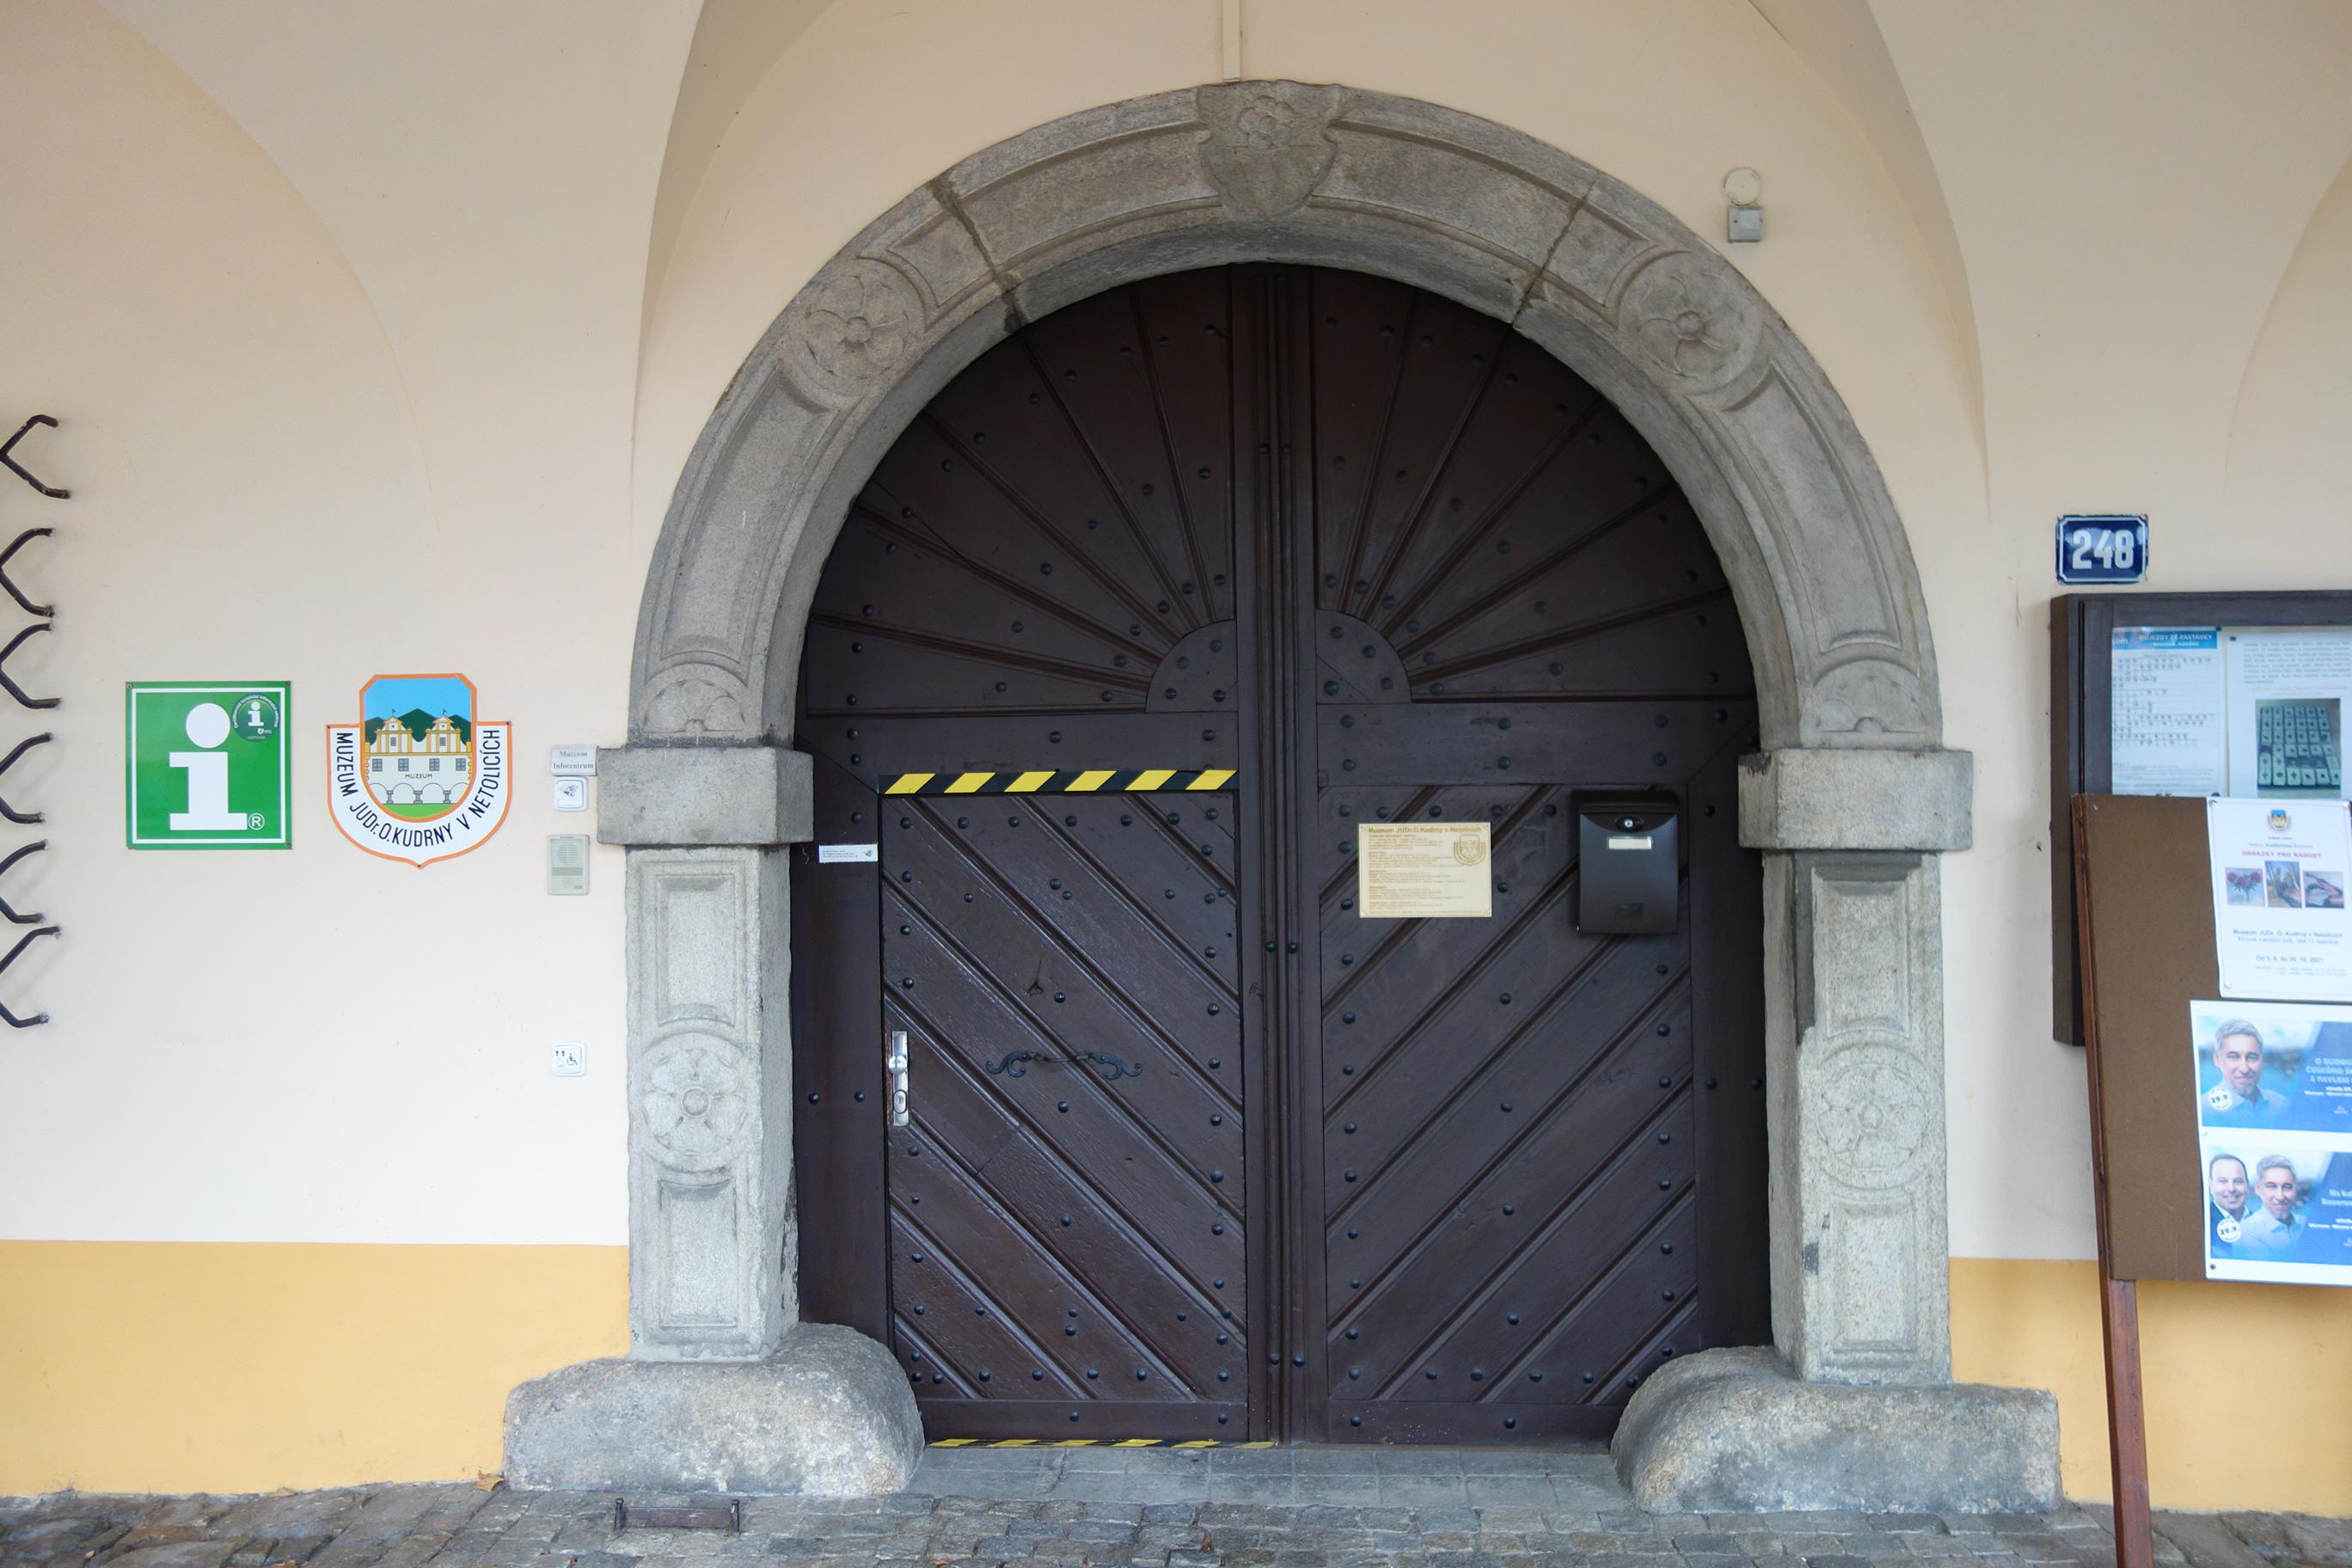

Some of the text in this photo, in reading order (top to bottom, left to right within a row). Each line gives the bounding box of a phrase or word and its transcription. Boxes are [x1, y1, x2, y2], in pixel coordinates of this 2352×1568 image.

[2072, 529, 2134, 569] 248
[336, 732, 358, 797] MUZEUM
[456, 813, 470, 830] V
[468, 729, 501, 818] NETOLICÍCH
